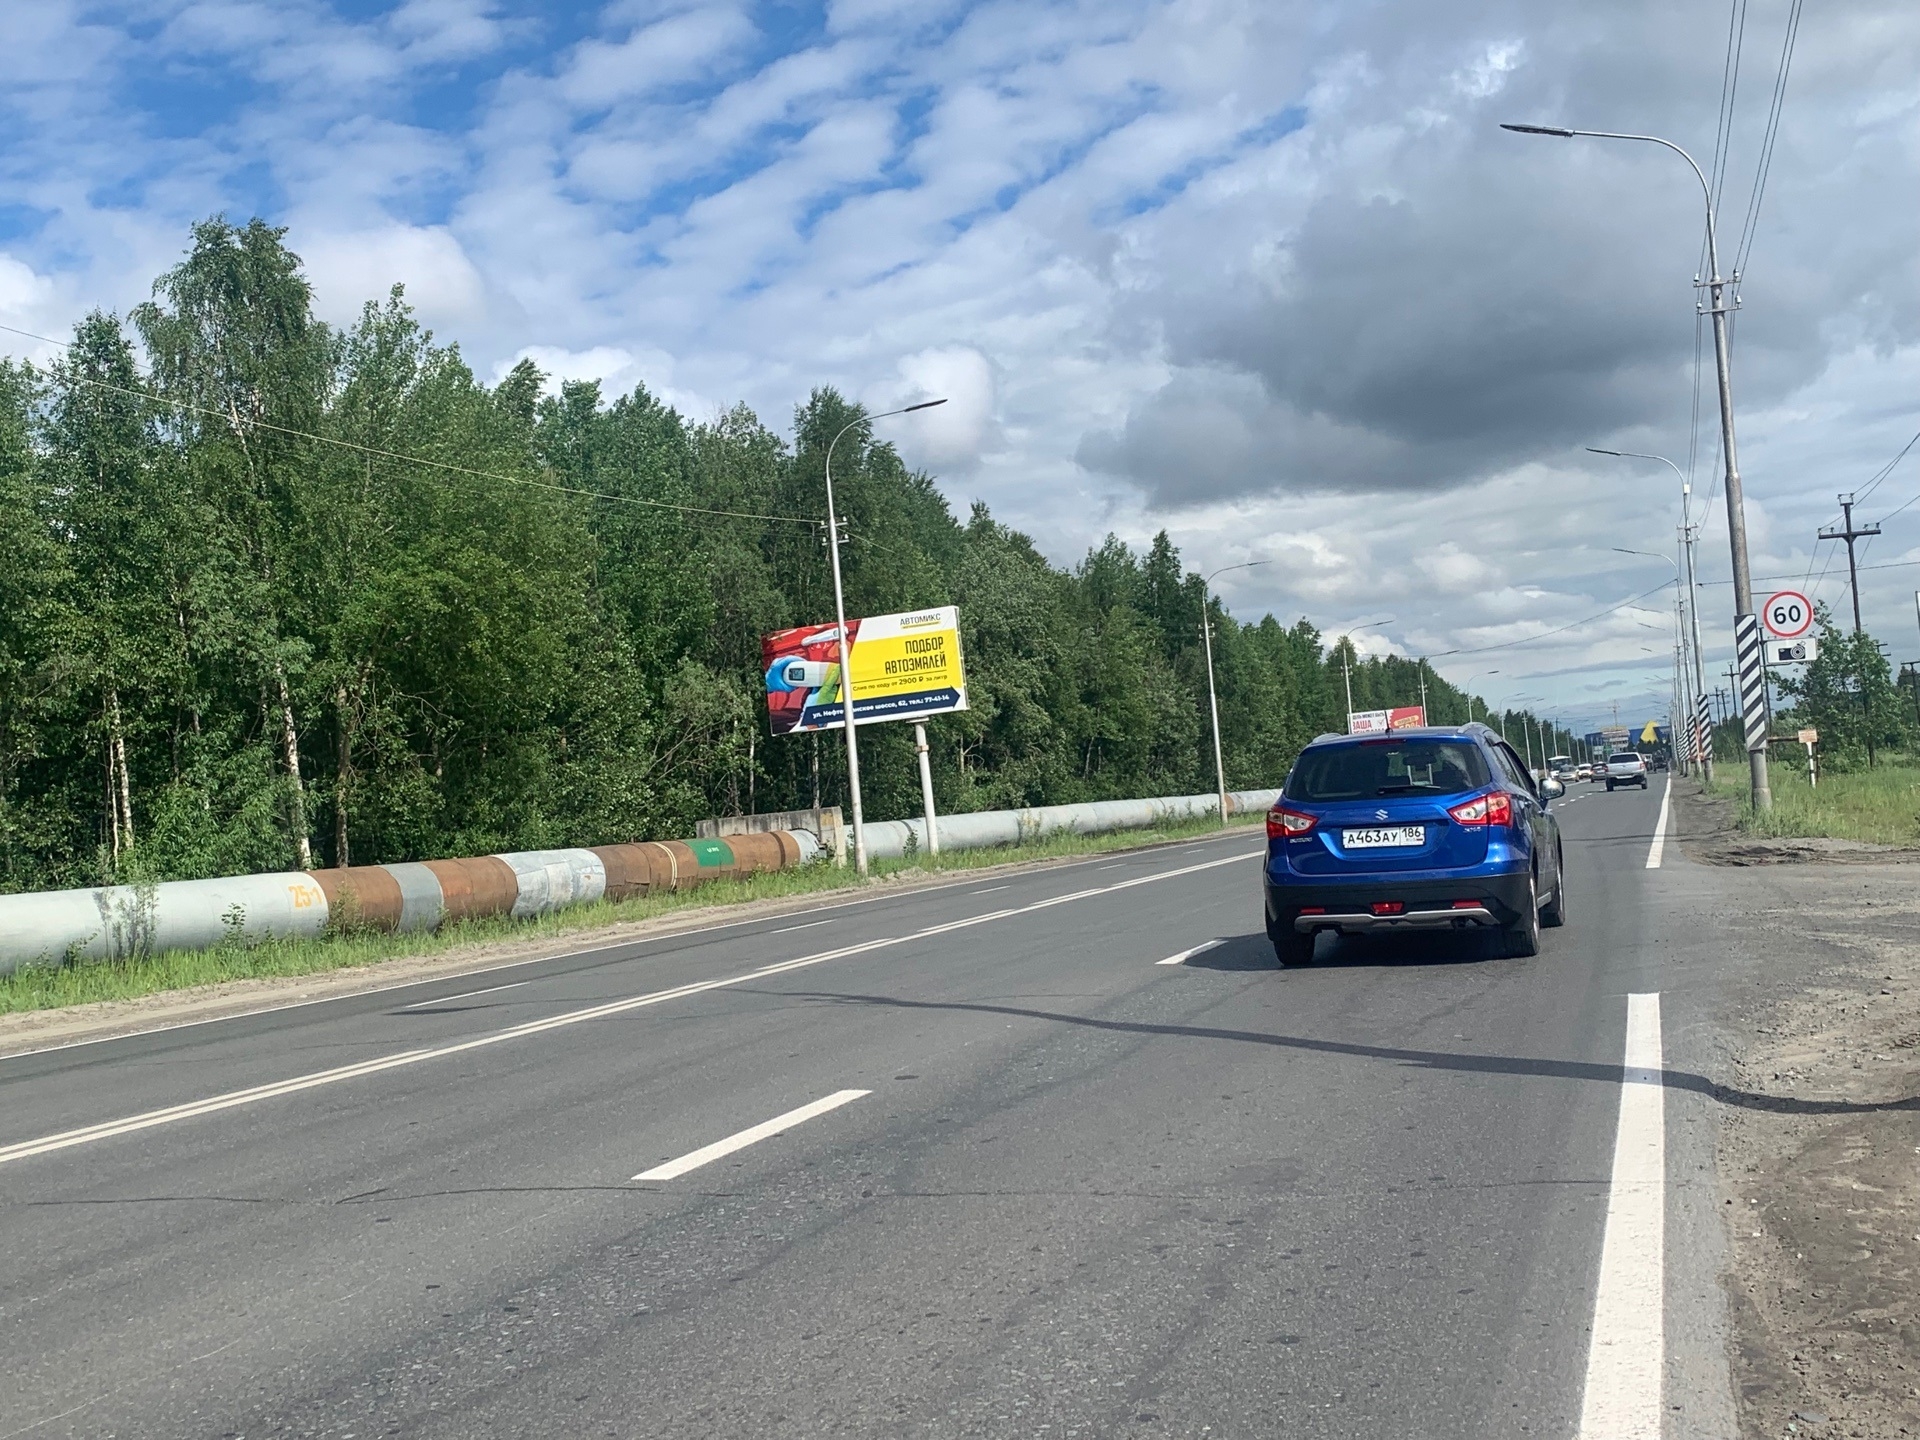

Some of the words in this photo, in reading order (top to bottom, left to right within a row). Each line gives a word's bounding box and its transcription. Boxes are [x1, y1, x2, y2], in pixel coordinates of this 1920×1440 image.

[900, 613, 941, 626] АВТОМИКС
[1774, 604, 1801, 624] 60
[905, 636, 944, 654] ПОДБОР
[885, 651, 947, 674] АВТОЭМАЛЕЙ
[899, 677, 917, 685] 2900
[812, 712, 822, 720] ул.
[875, 702, 898, 710] шоссе,
[1402, 827, 1421, 838] 186
